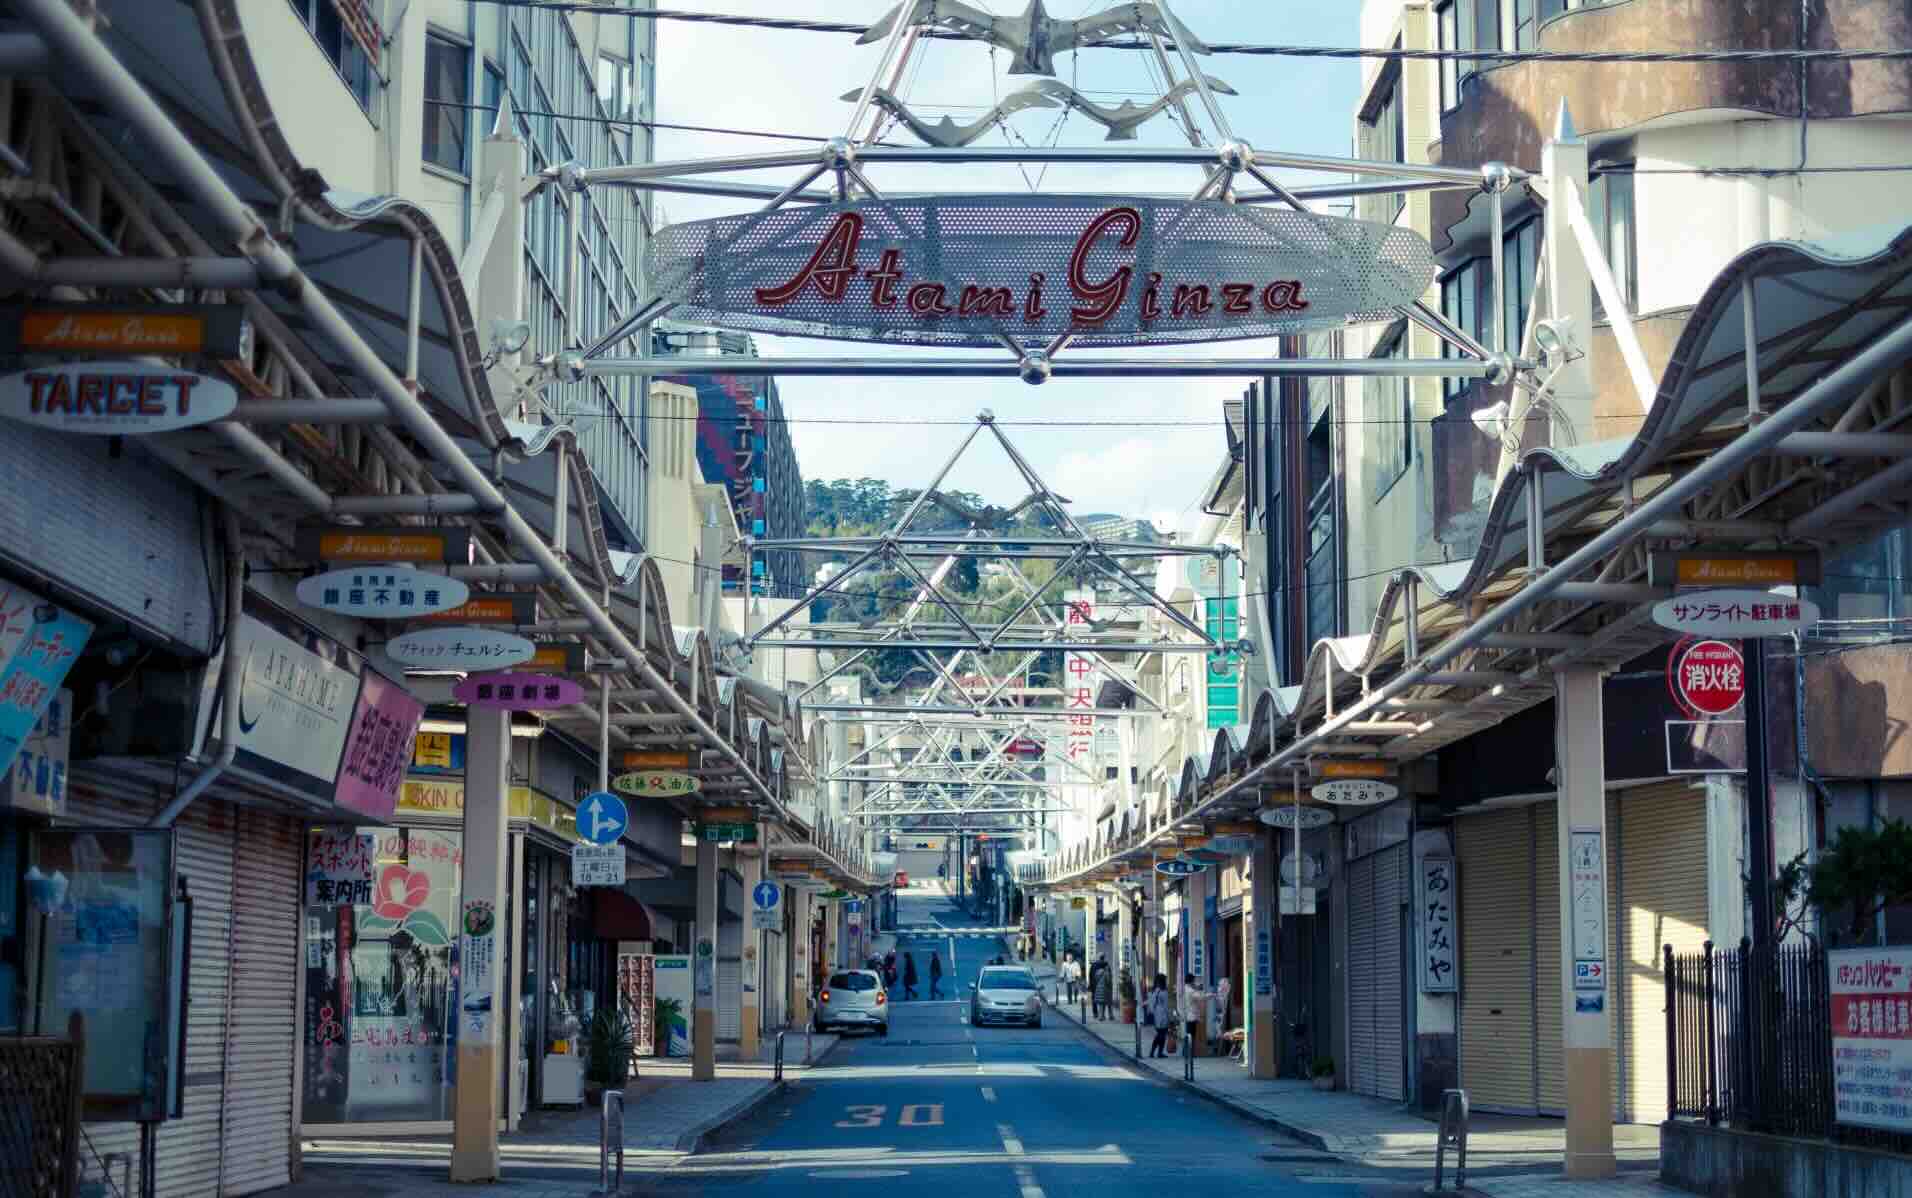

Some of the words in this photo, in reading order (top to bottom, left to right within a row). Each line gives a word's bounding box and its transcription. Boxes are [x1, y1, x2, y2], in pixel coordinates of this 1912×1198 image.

[755, 211, 1046, 321] Atami
[1068, 207, 1308, 329] Ginza
[24, 372, 200, 416] TARGET
[323, 589, 440, 606] 銀座不動産
[1673, 603, 1801, 622] サンライト駐車場
[1686, 664, 1742, 691] 消火栓
[316, 879, 371, 904] 案内所
[1847, 999, 1912, 1034] お客様駐車
[833, 1103, 945, 1128] 30
